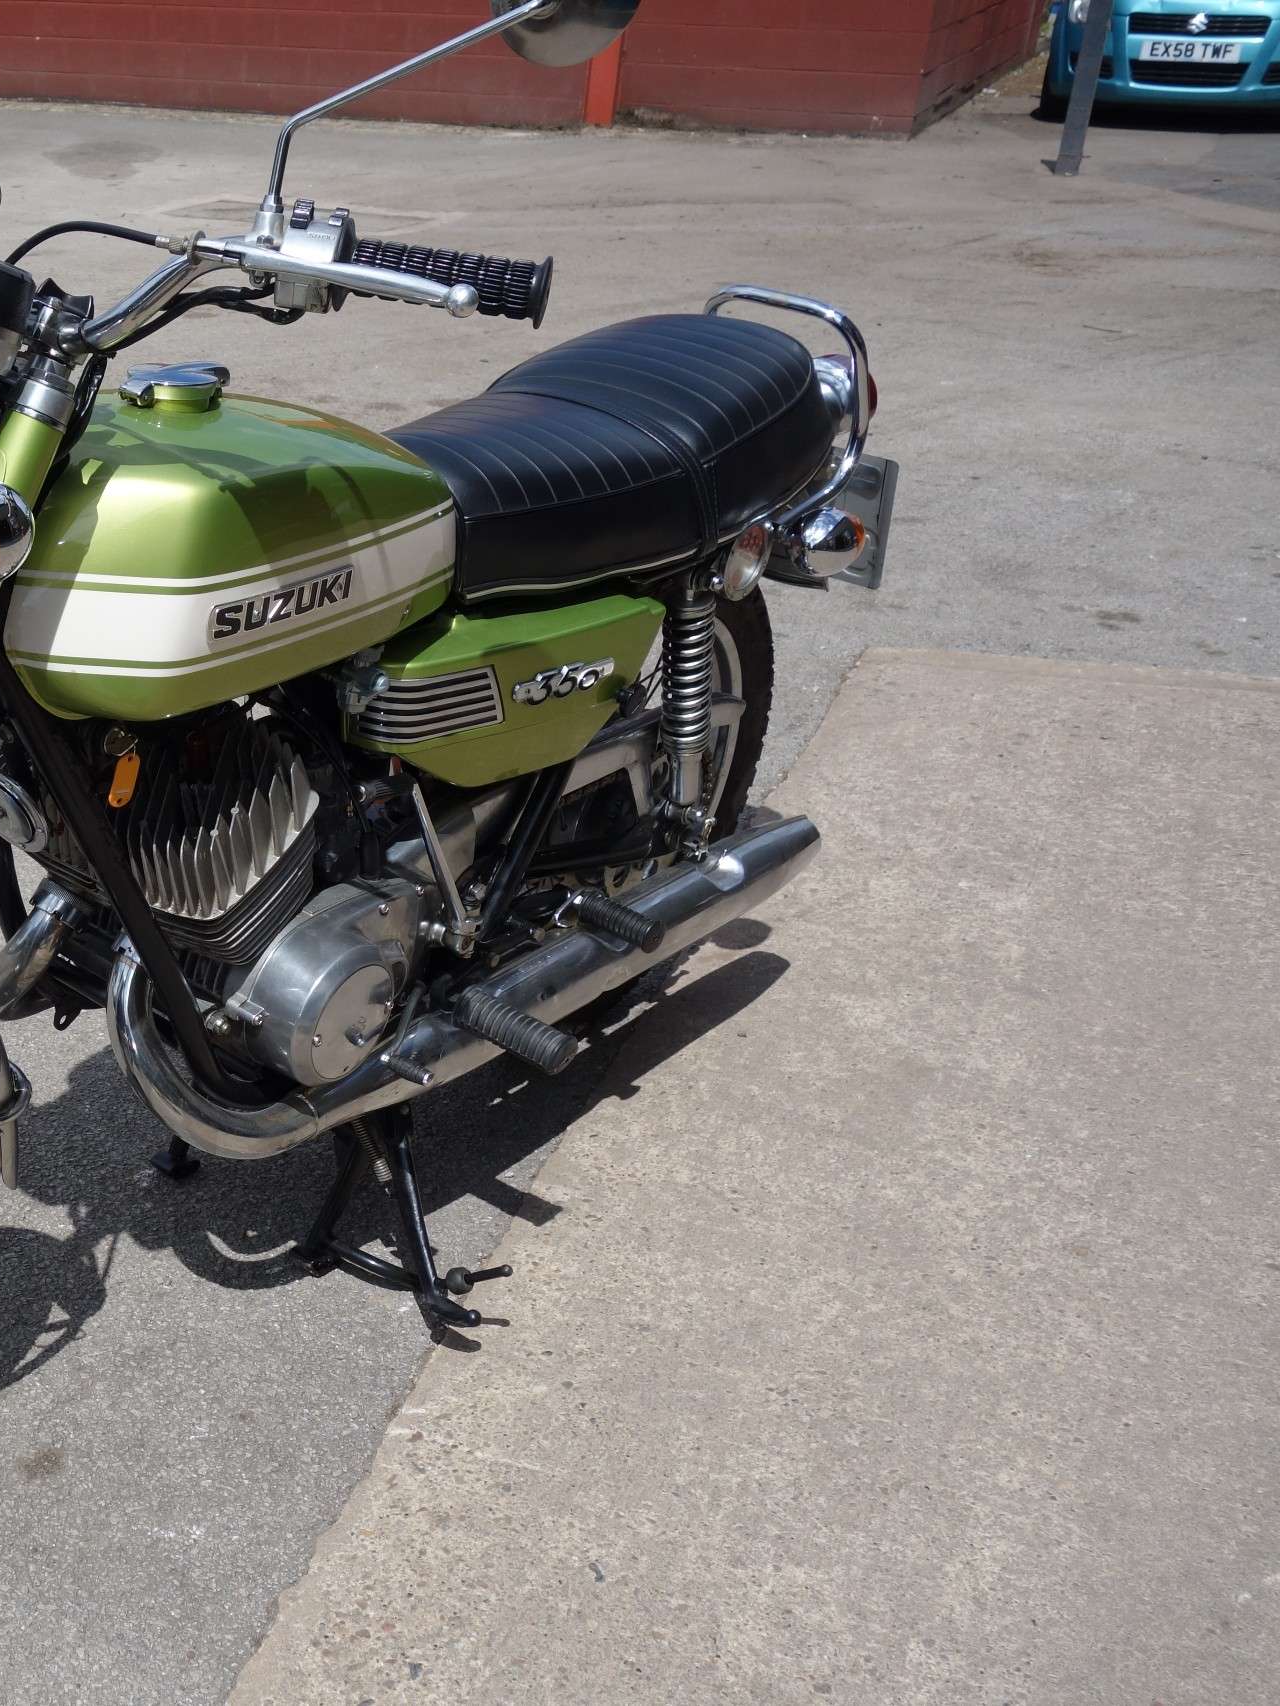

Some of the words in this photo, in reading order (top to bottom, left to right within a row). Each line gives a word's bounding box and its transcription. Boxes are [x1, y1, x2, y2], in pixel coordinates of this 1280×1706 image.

[1149, 41, 1196, 58] EX58
[1200, 43, 1235, 59] TWF
[213, 570, 354, 640] SUZUKI
[526, 661, 600, 705] 350
